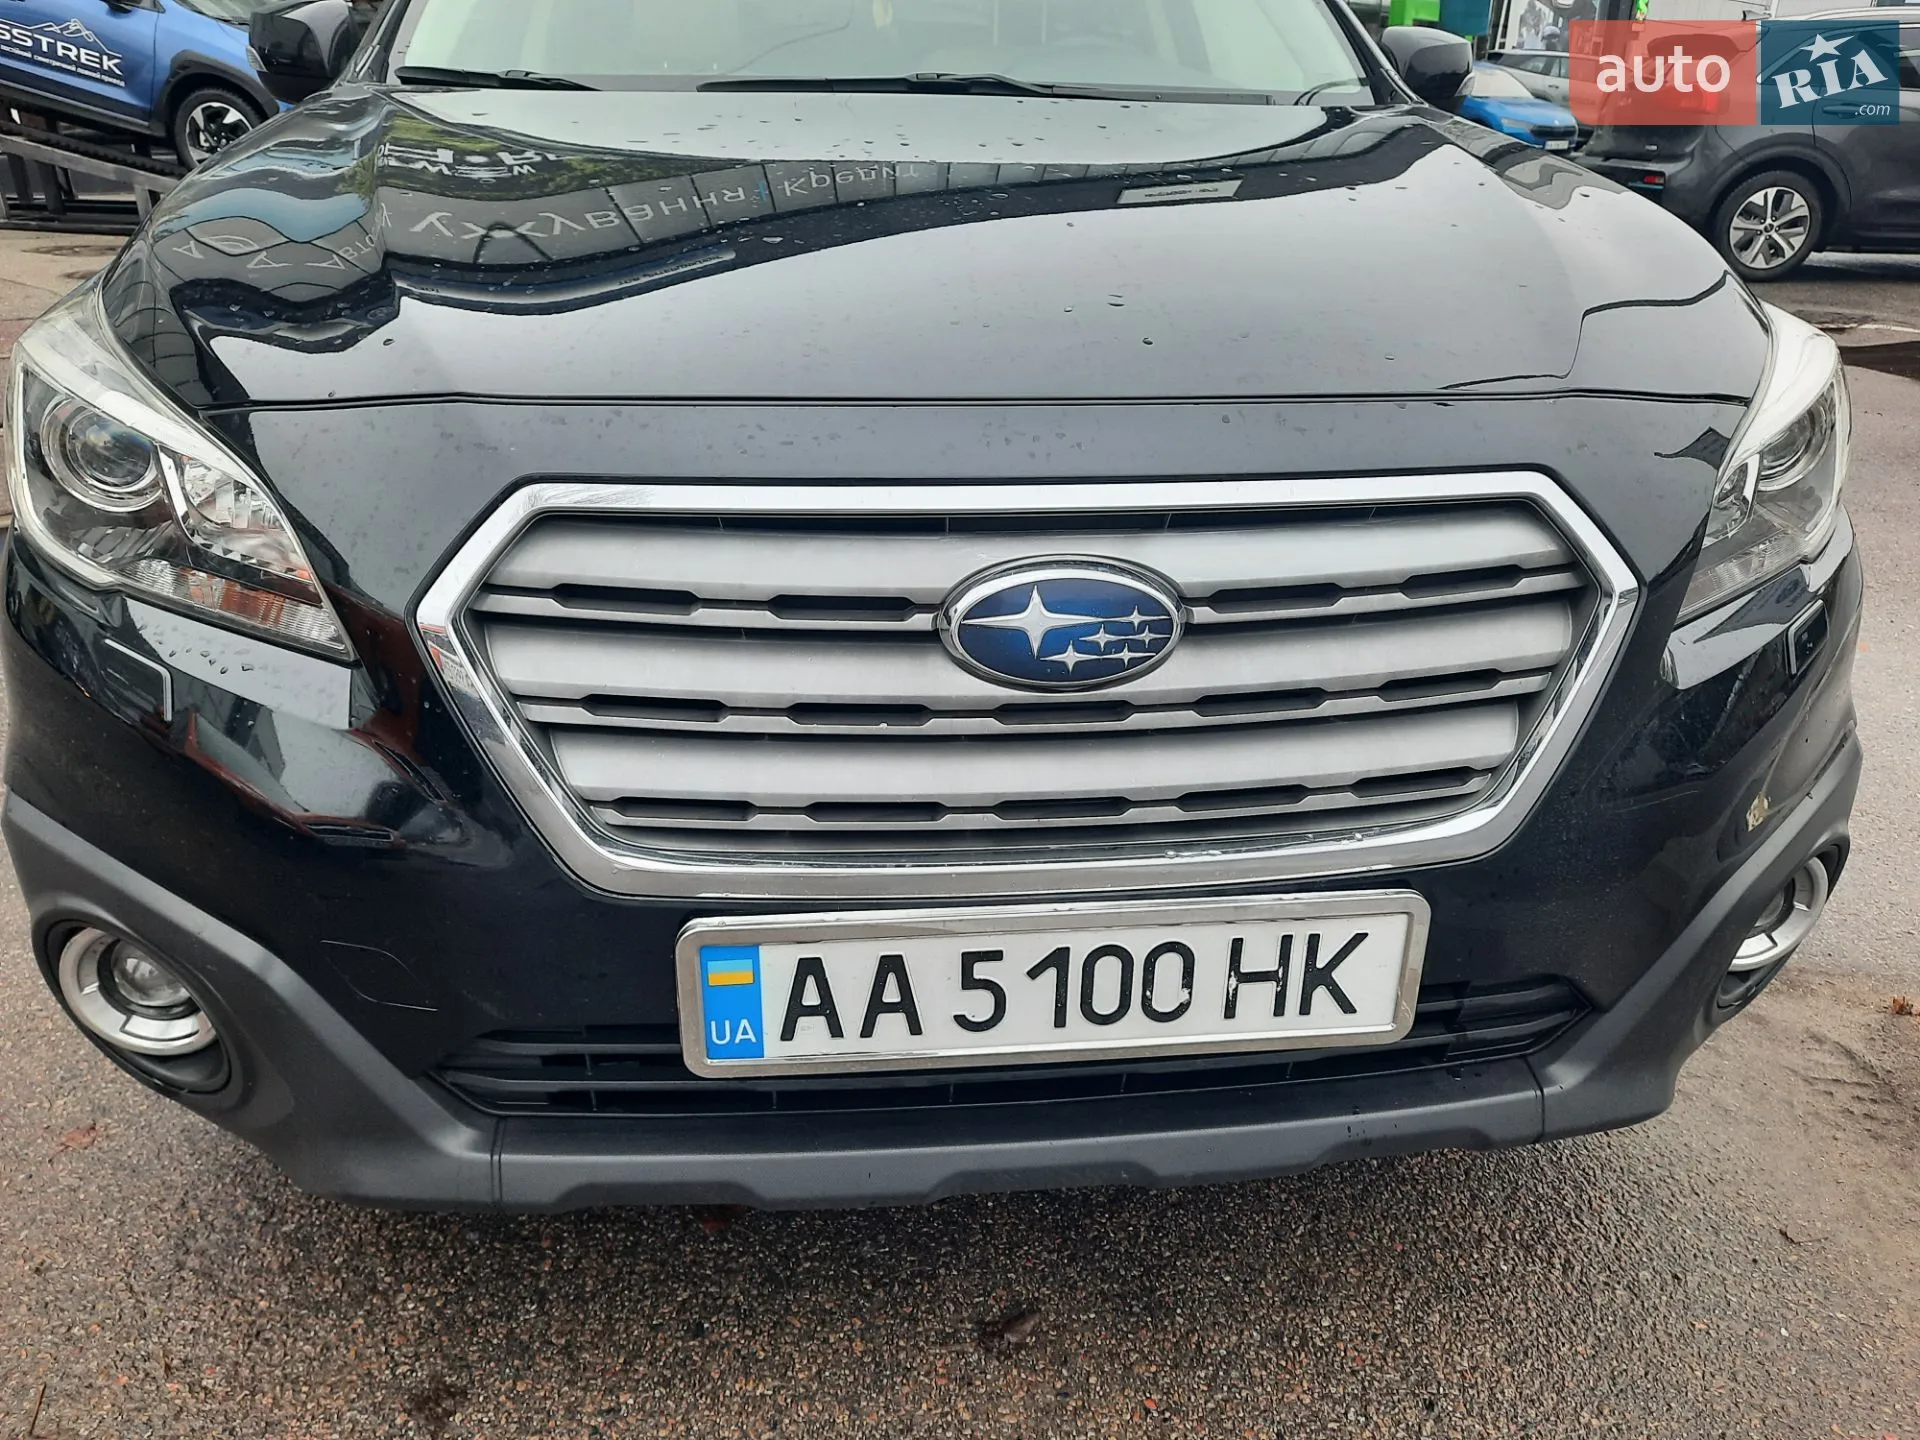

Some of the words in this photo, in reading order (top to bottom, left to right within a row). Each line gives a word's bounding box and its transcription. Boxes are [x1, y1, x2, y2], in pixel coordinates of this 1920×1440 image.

[780, 955, 923, 1042] AA
[952, 940, 1196, 1033] 5100
[1223, 932, 1370, 1020] HK
[710, 1018, 757, 1045] UA
